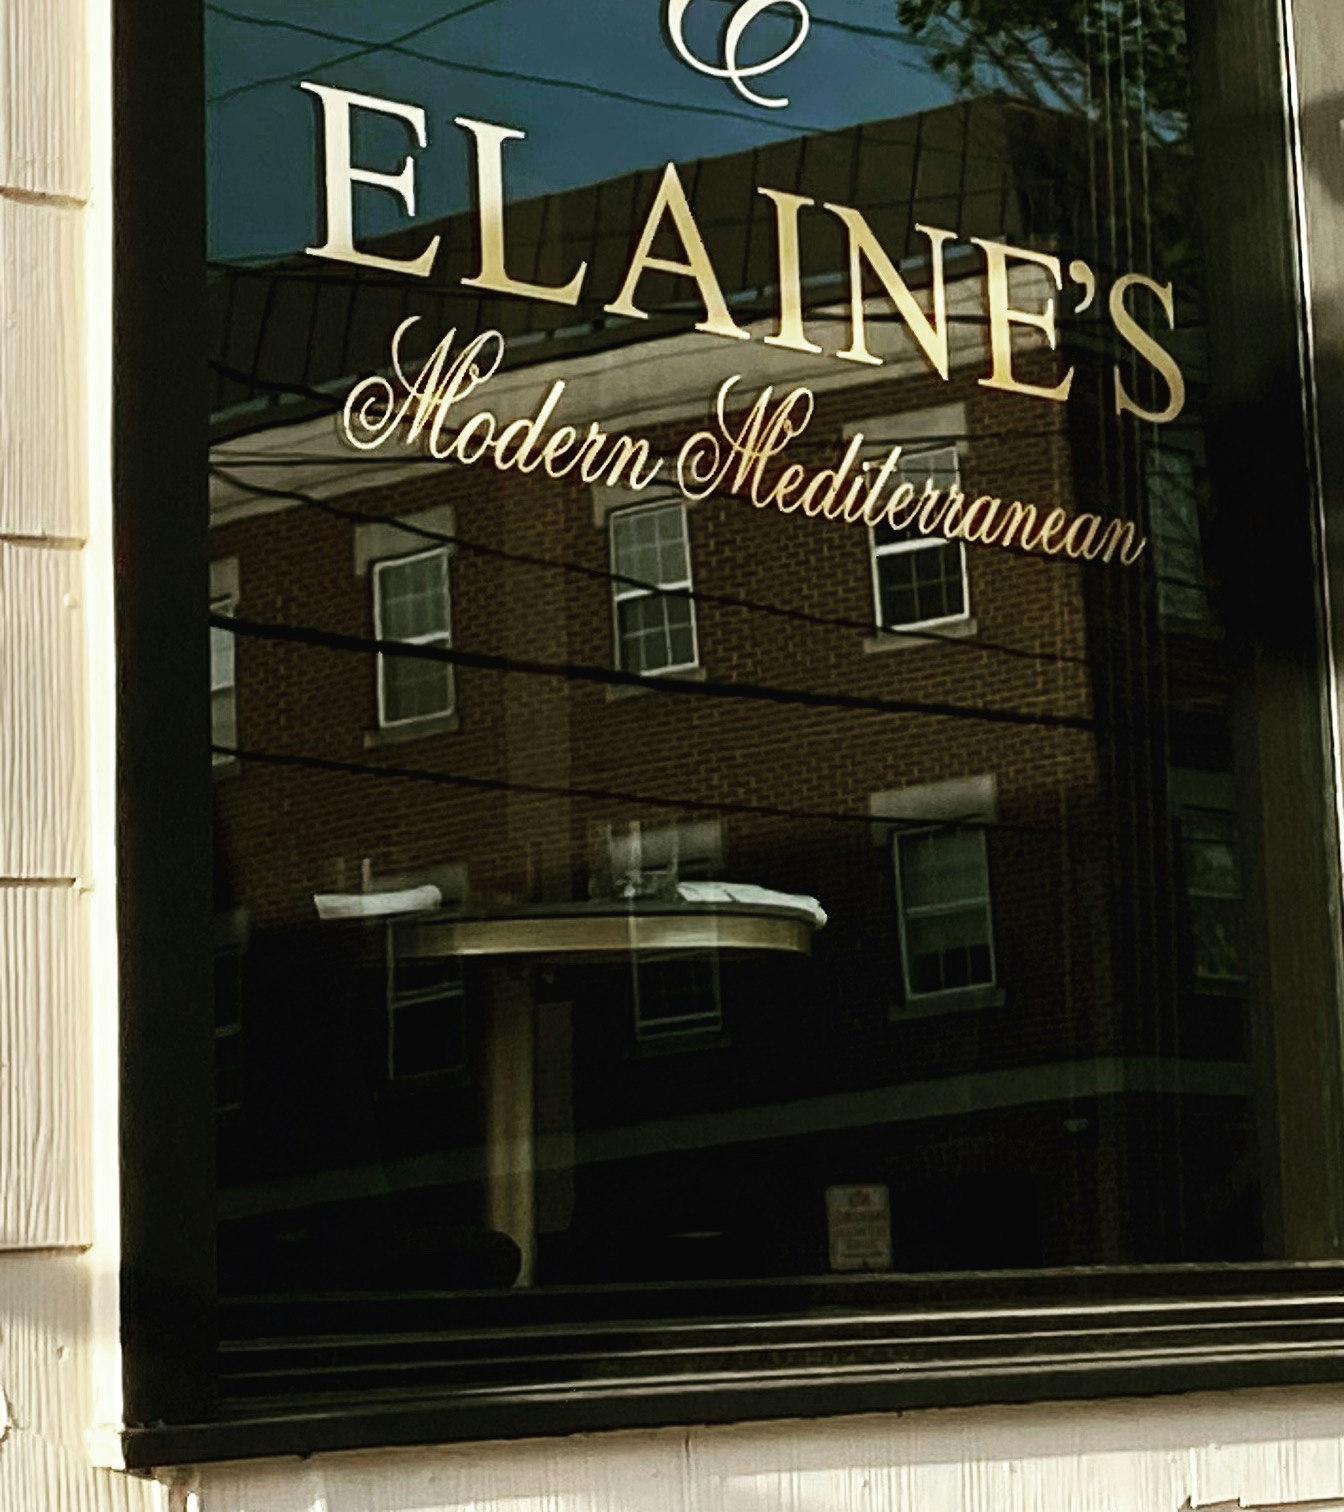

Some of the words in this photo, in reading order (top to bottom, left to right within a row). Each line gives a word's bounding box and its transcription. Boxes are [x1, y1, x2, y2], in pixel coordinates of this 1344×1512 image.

[300, 81, 1186, 424] ELAINE'S
[343, 316, 662, 489] Modern
[676, 374, 1146, 566] Mediterranean
